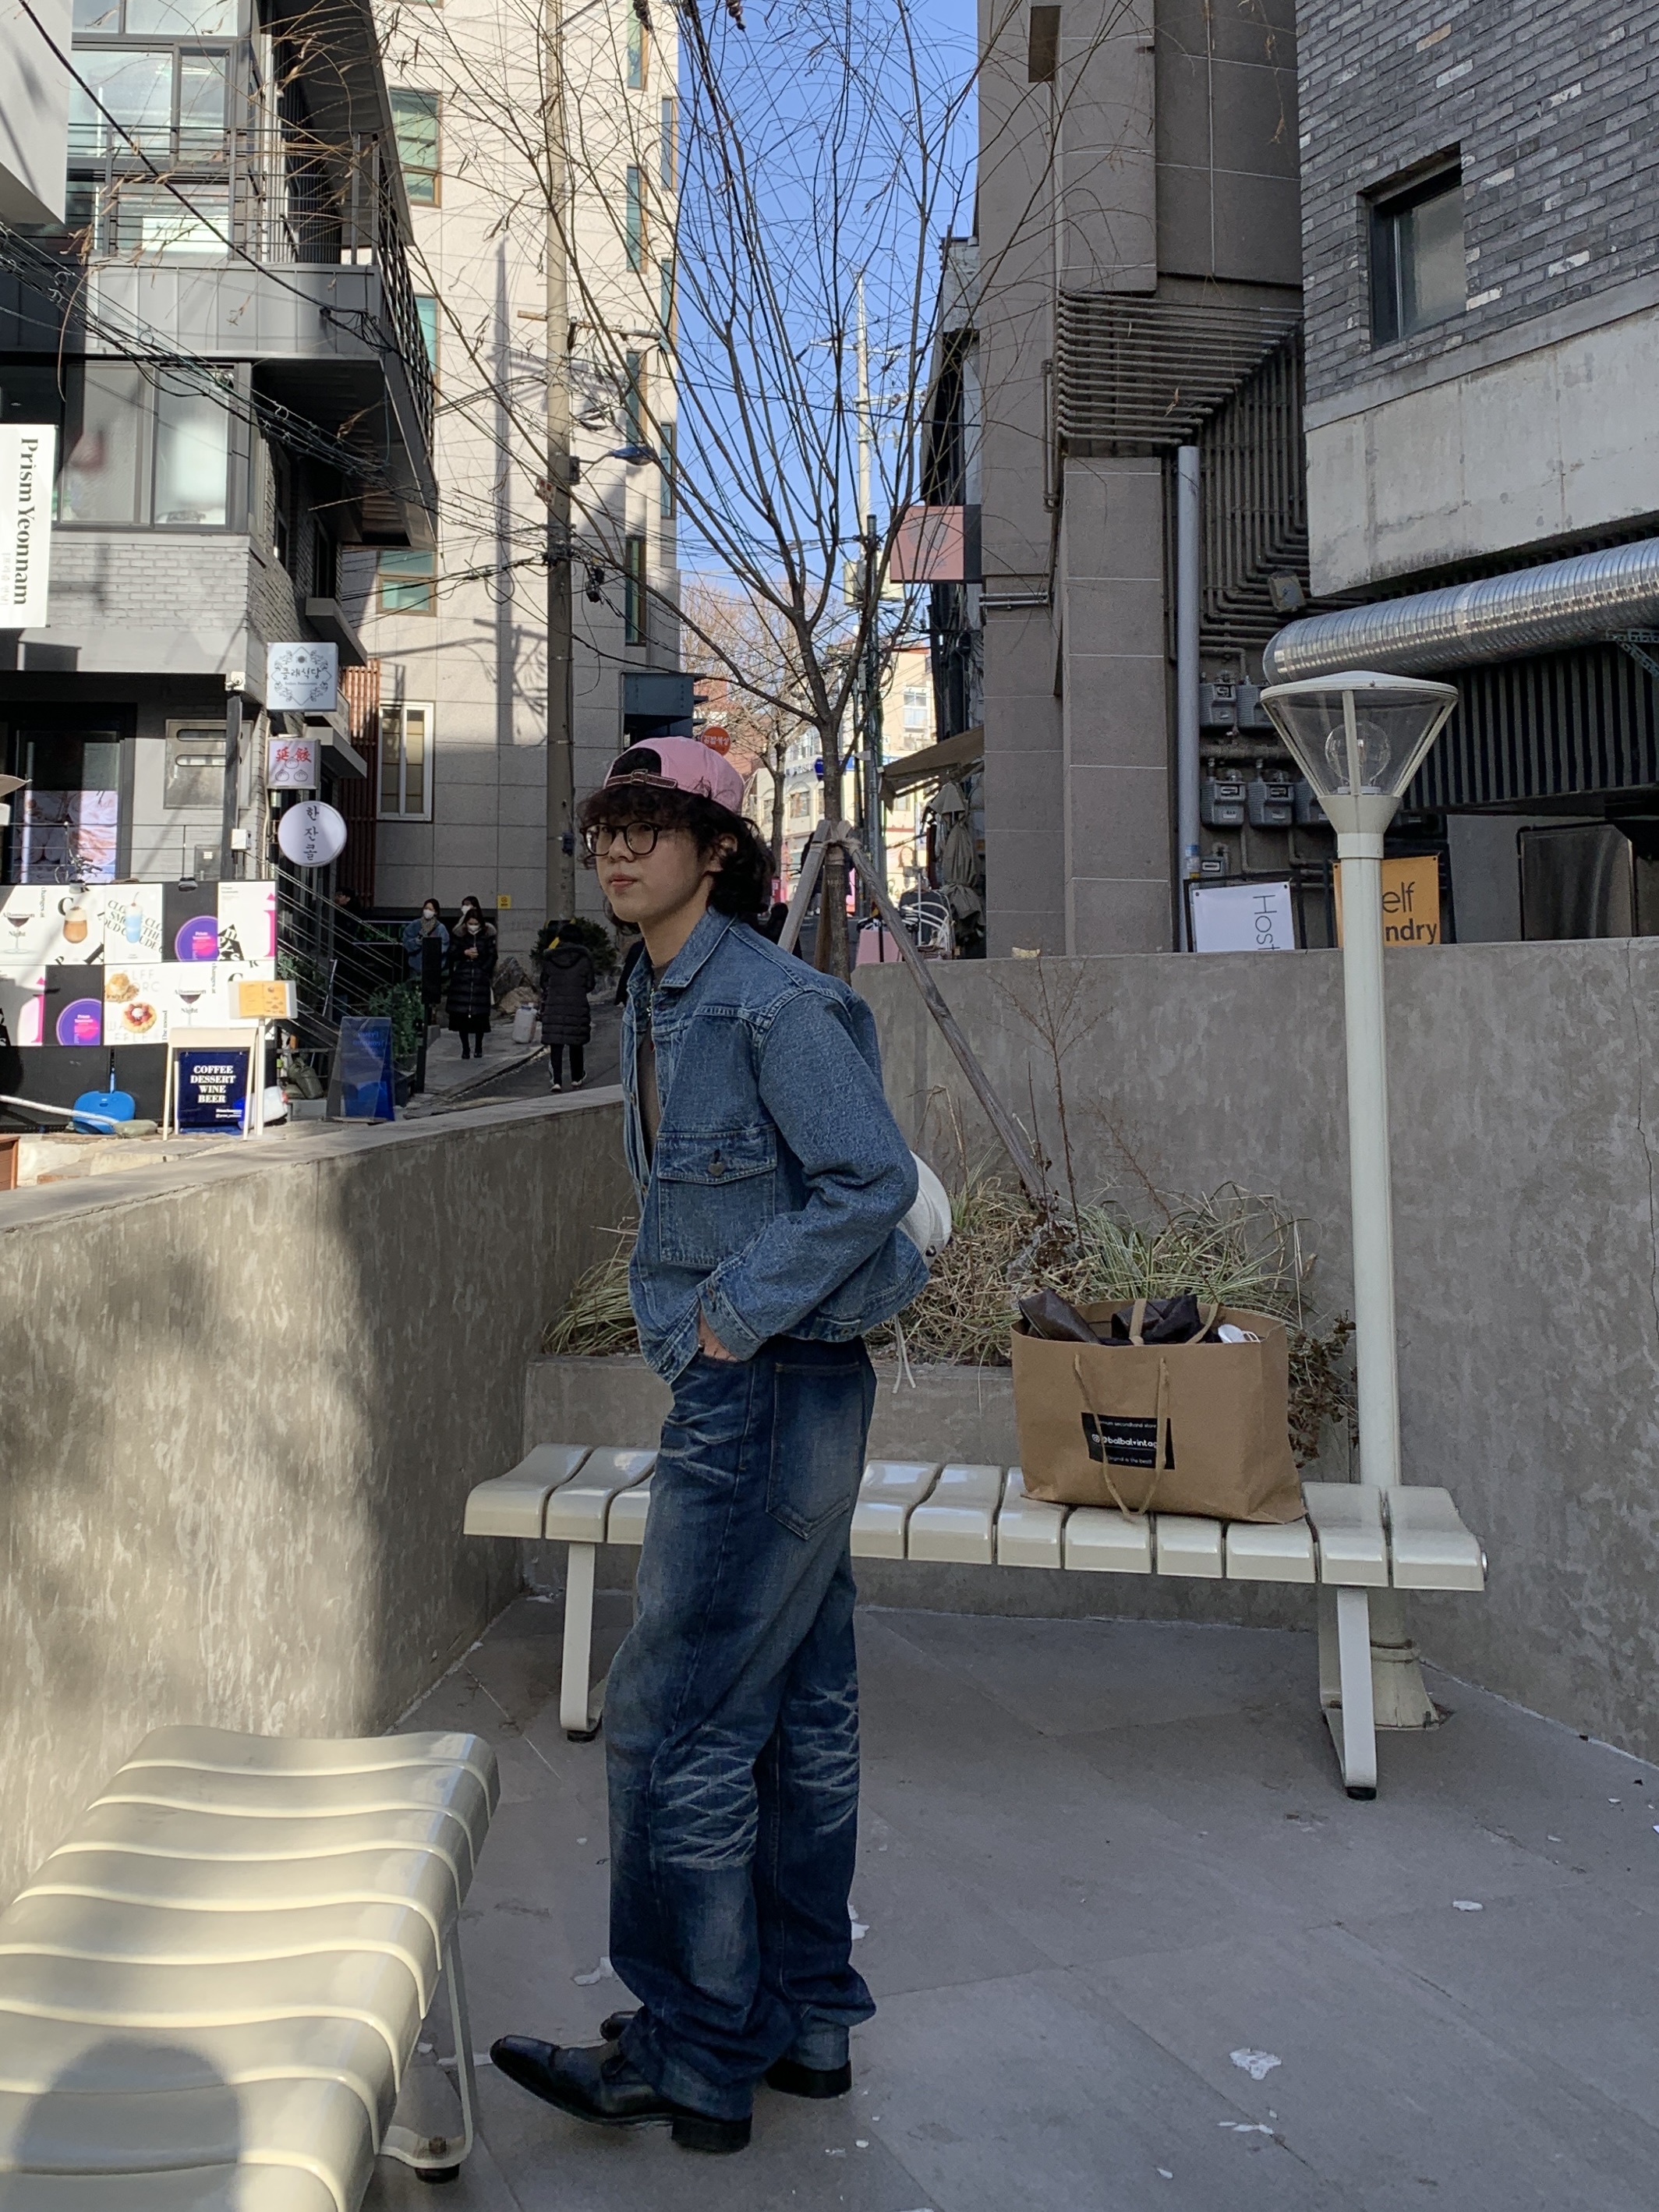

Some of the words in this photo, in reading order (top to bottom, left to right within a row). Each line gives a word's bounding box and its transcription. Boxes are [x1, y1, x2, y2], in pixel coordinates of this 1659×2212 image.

[19, 437, 39, 503] Prism
[13, 504, 36, 605] Yeonnam
[1382, 881, 1416, 914] elf
[1385, 918, 1438, 945] ndry
[193, 1065, 234, 1074] COFFEE
[189, 1074, 237, 1084] DESSERT
[198, 1085, 227, 1093] WINE
[197, 1095, 226, 1103] BEER
